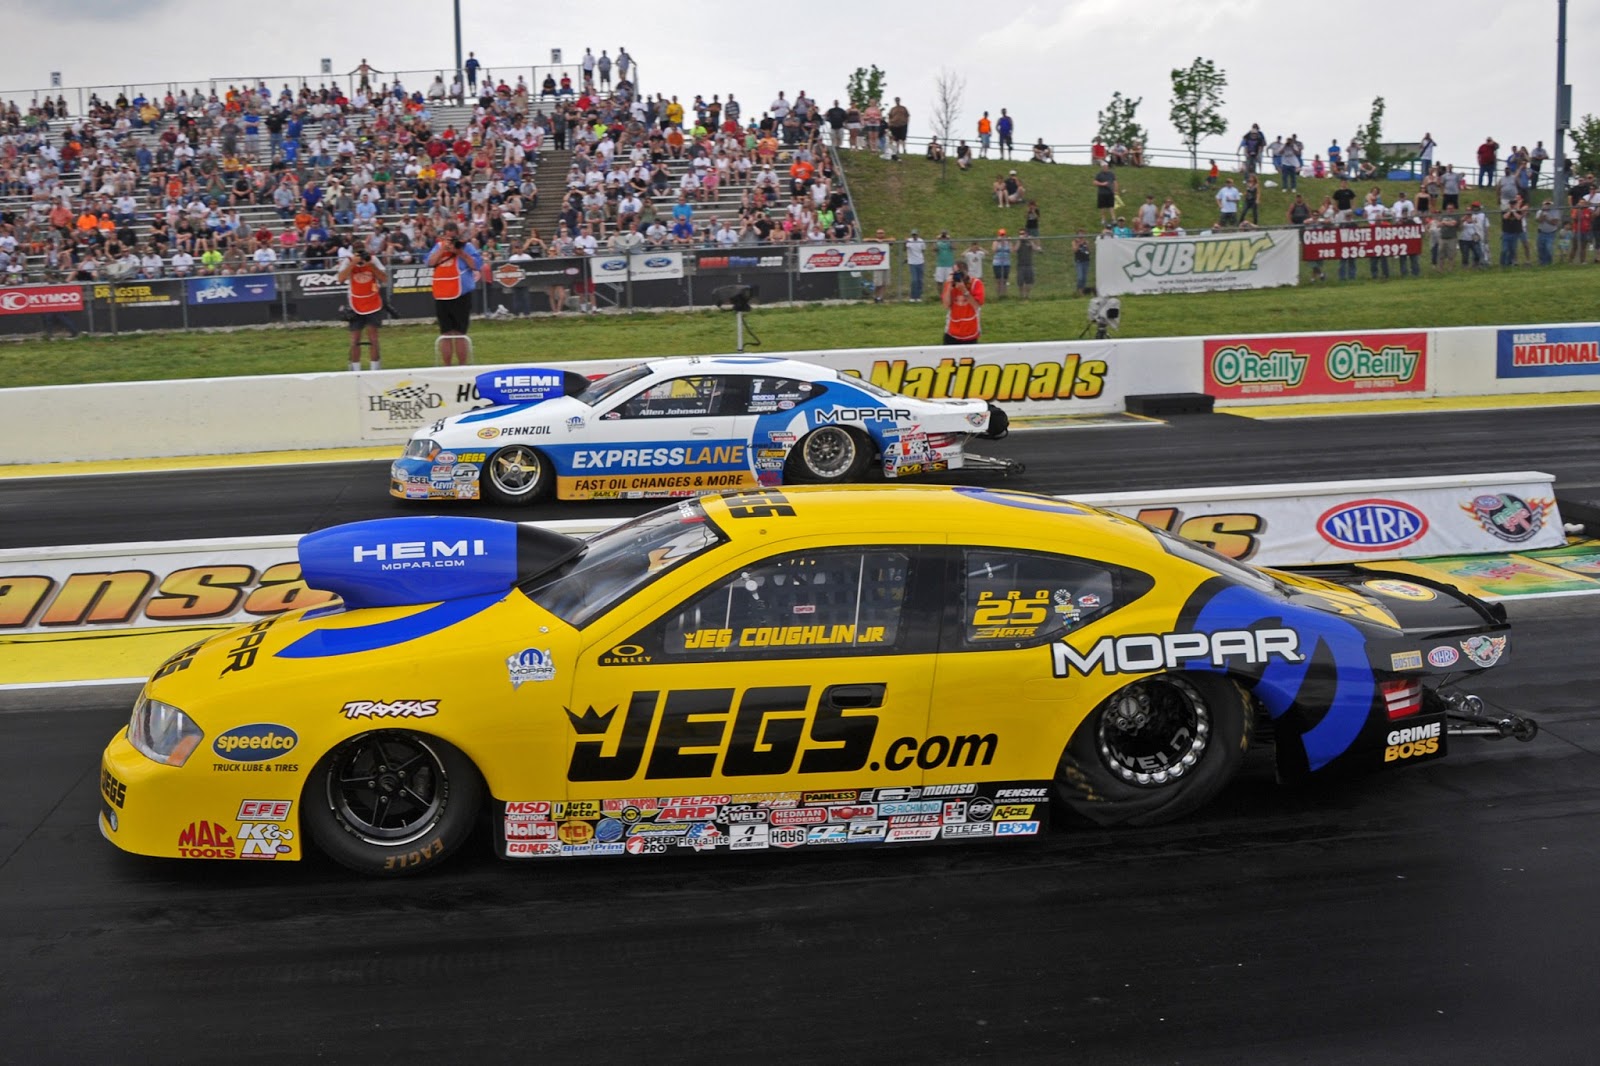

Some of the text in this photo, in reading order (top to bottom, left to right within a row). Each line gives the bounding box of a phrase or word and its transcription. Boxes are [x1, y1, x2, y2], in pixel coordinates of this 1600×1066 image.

[1303, 225, 1421, 245] OSAGE WASTE DISPOSAL
[1318, 243, 1407, 259] 785 836-9392
[1126, 236, 1268, 279] SUBWAY
[29, 293, 80, 304] KYMCO
[196, 285, 237, 302] PEAK
[1513, 332, 1547, 343] KANSAS
[1214, 346, 1307, 384] O'Reilly
[1329, 342, 1419, 380] O'Reilly
[494, 376, 560, 388] HEMI
[870, 354, 1107, 400] Nationals
[368, 393, 443, 411] HEARTLAND
[389, 409, 424, 420] PARK
[639, 409, 663, 417] Allen
[816, 408, 912, 424] MOPAR
[501, 425, 551, 436] PENNZOIL
[458, 453, 486, 462] JEGS
[575, 475, 743, 491] FAST OIL CHANGES & MORE
[1332, 507, 1415, 543] NHRA
[353, 539, 485, 563] HEMI
[381, 560, 465, 571] MOPAR.COM
[978, 590, 1050, 600] PRO
[972, 599, 1050, 626] 25
[684, 624, 885, 649] JEG COUGHLIN JR
[1053, 629, 1302, 677] MOPAR
[1431, 650, 1456, 665] NHRA
[604, 656, 652, 664] OAKLEY
[1394, 656, 1422, 670] BOSTON
[510, 667, 553, 675] MOPAR
[341, 699, 441, 720] TRAXXAS
[566, 682, 999, 783] JEGS.com
[1387, 722, 1441, 746] GRIME
[217, 732, 294, 753] speedco
[1384, 737, 1440, 762] BOSS
[213, 763, 298, 772] TRUCK LUBE & TIRES
[922, 784, 976, 796] MOROSO
[995, 788, 1047, 798] PENSKE
[805, 792, 856, 801] PAINLESS
[241, 801, 290, 817] CFE
[507, 802, 550, 814] MSD
[567, 802, 593, 810] Auto
[897, 802, 940, 813] RICHMOND
[565, 810, 598, 818] Meter
[658, 807, 716, 820] ARP
[729, 812, 767, 821] WELD
[775, 810, 821, 818] HEDMAN
[831, 806, 875, 820] WORLD
[891, 813, 940, 824] HUGHES
[178, 820, 235, 848] MAC
[507, 822, 556, 839] Holley
[561, 825, 588, 838] TCI
[945, 823, 991, 833] STEF'S
[997, 823, 1038, 834] B&M
[643, 836, 677, 845] SPEED
[178, 848, 236, 858] TOOLS
[384, 837, 444, 870] EAGLE
[509, 843, 549, 853] COMP
[562, 843, 624, 852] Blue Print
[642, 844, 666, 853] PRO
